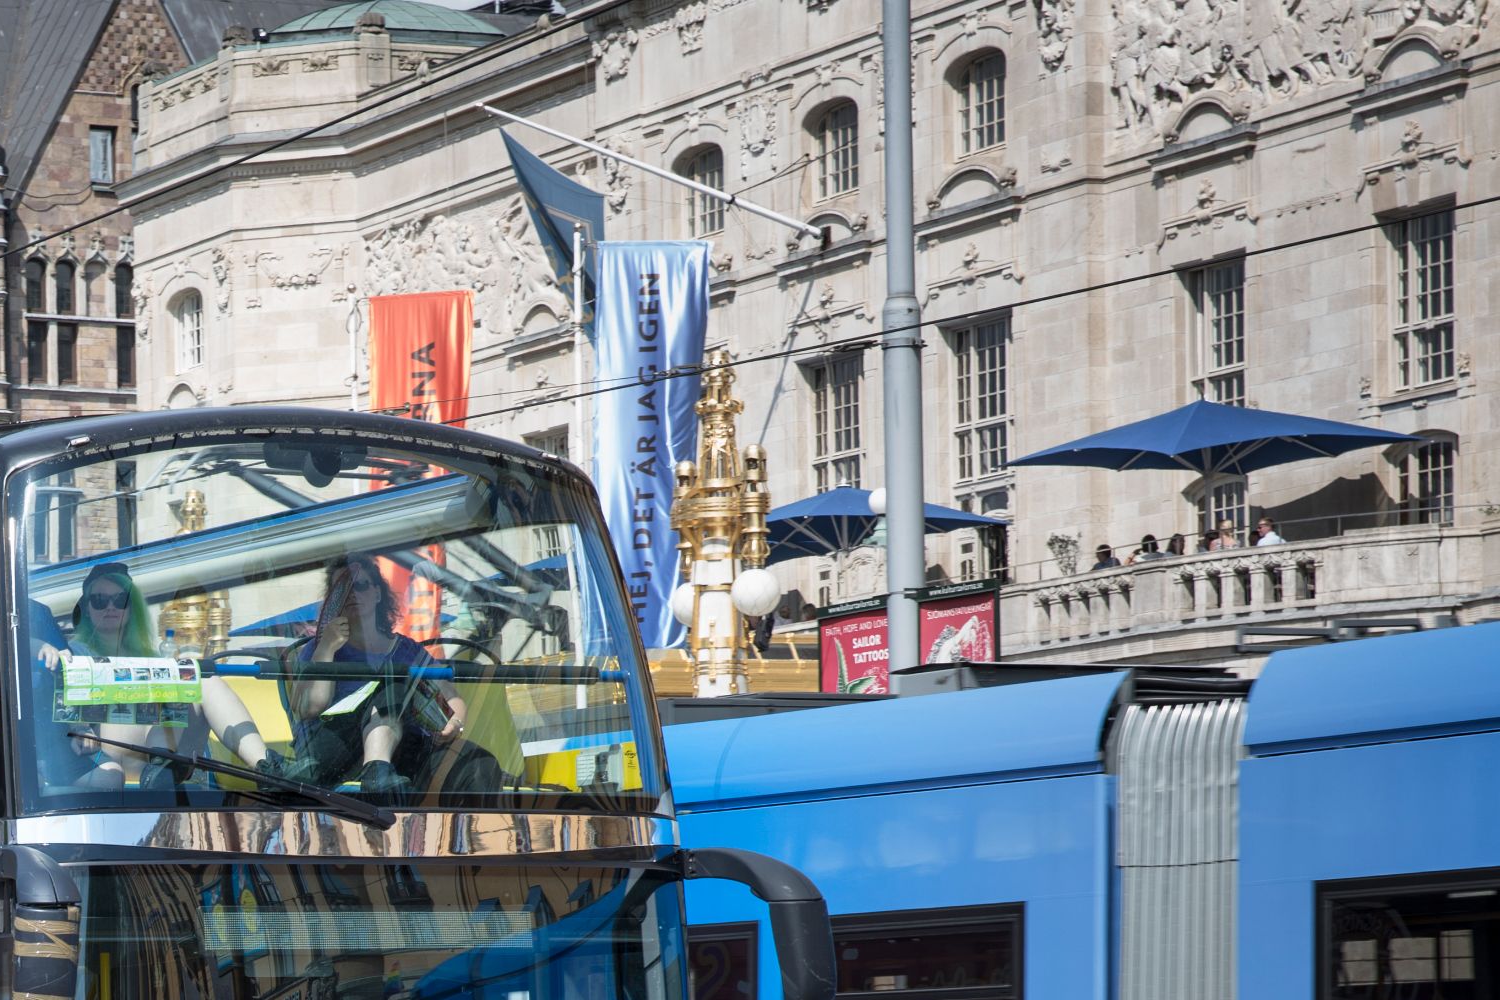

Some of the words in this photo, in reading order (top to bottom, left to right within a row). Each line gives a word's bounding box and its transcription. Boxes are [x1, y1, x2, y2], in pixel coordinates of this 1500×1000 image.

[638, 273, 661, 353] IGEN
[637, 365, 660, 426] JAG
[631, 434, 657, 478] ÄR
[633, 487, 655, 550] DET
[852, 634, 882, 649] SAILOR
[852, 648, 890, 664] TATTOOS
